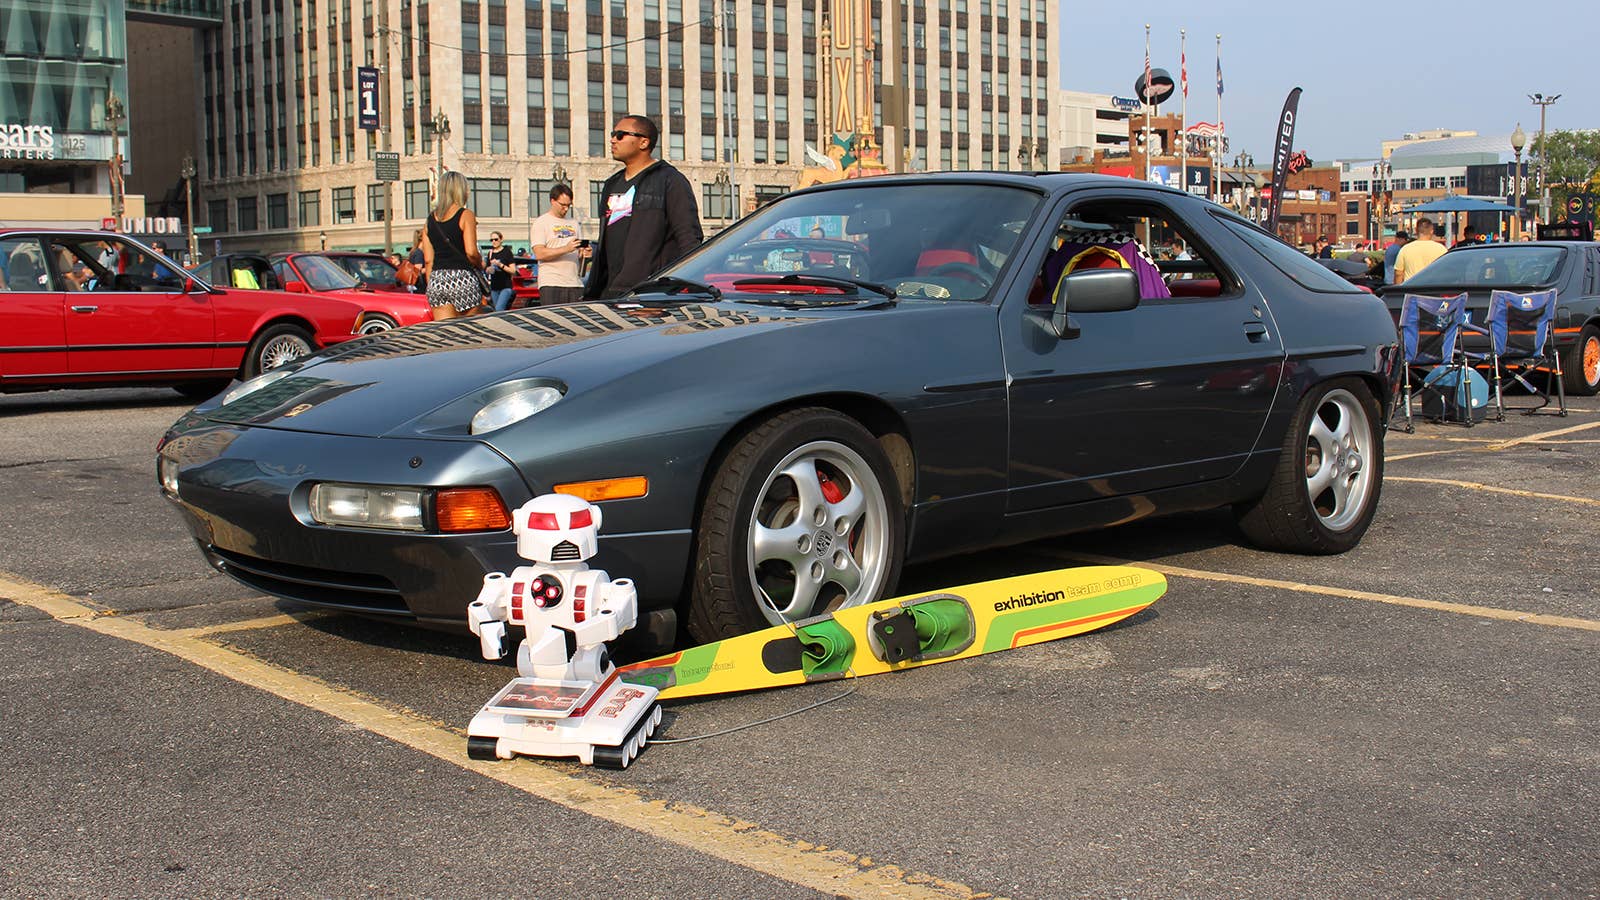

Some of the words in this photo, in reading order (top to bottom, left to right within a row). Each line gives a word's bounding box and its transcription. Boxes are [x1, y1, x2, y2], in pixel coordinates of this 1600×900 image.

[362, 81, 375, 89] LOT
[362, 90, 377, 116] 1
[68, 138, 86, 151] 125
[122, 217, 180, 234] UNION
[1474, 231, 1499, 244] oogle
[994, 589, 1066, 612] exhibition
[1066, 581, 1102, 598] team
[1103, 573, 1142, 590] comp
